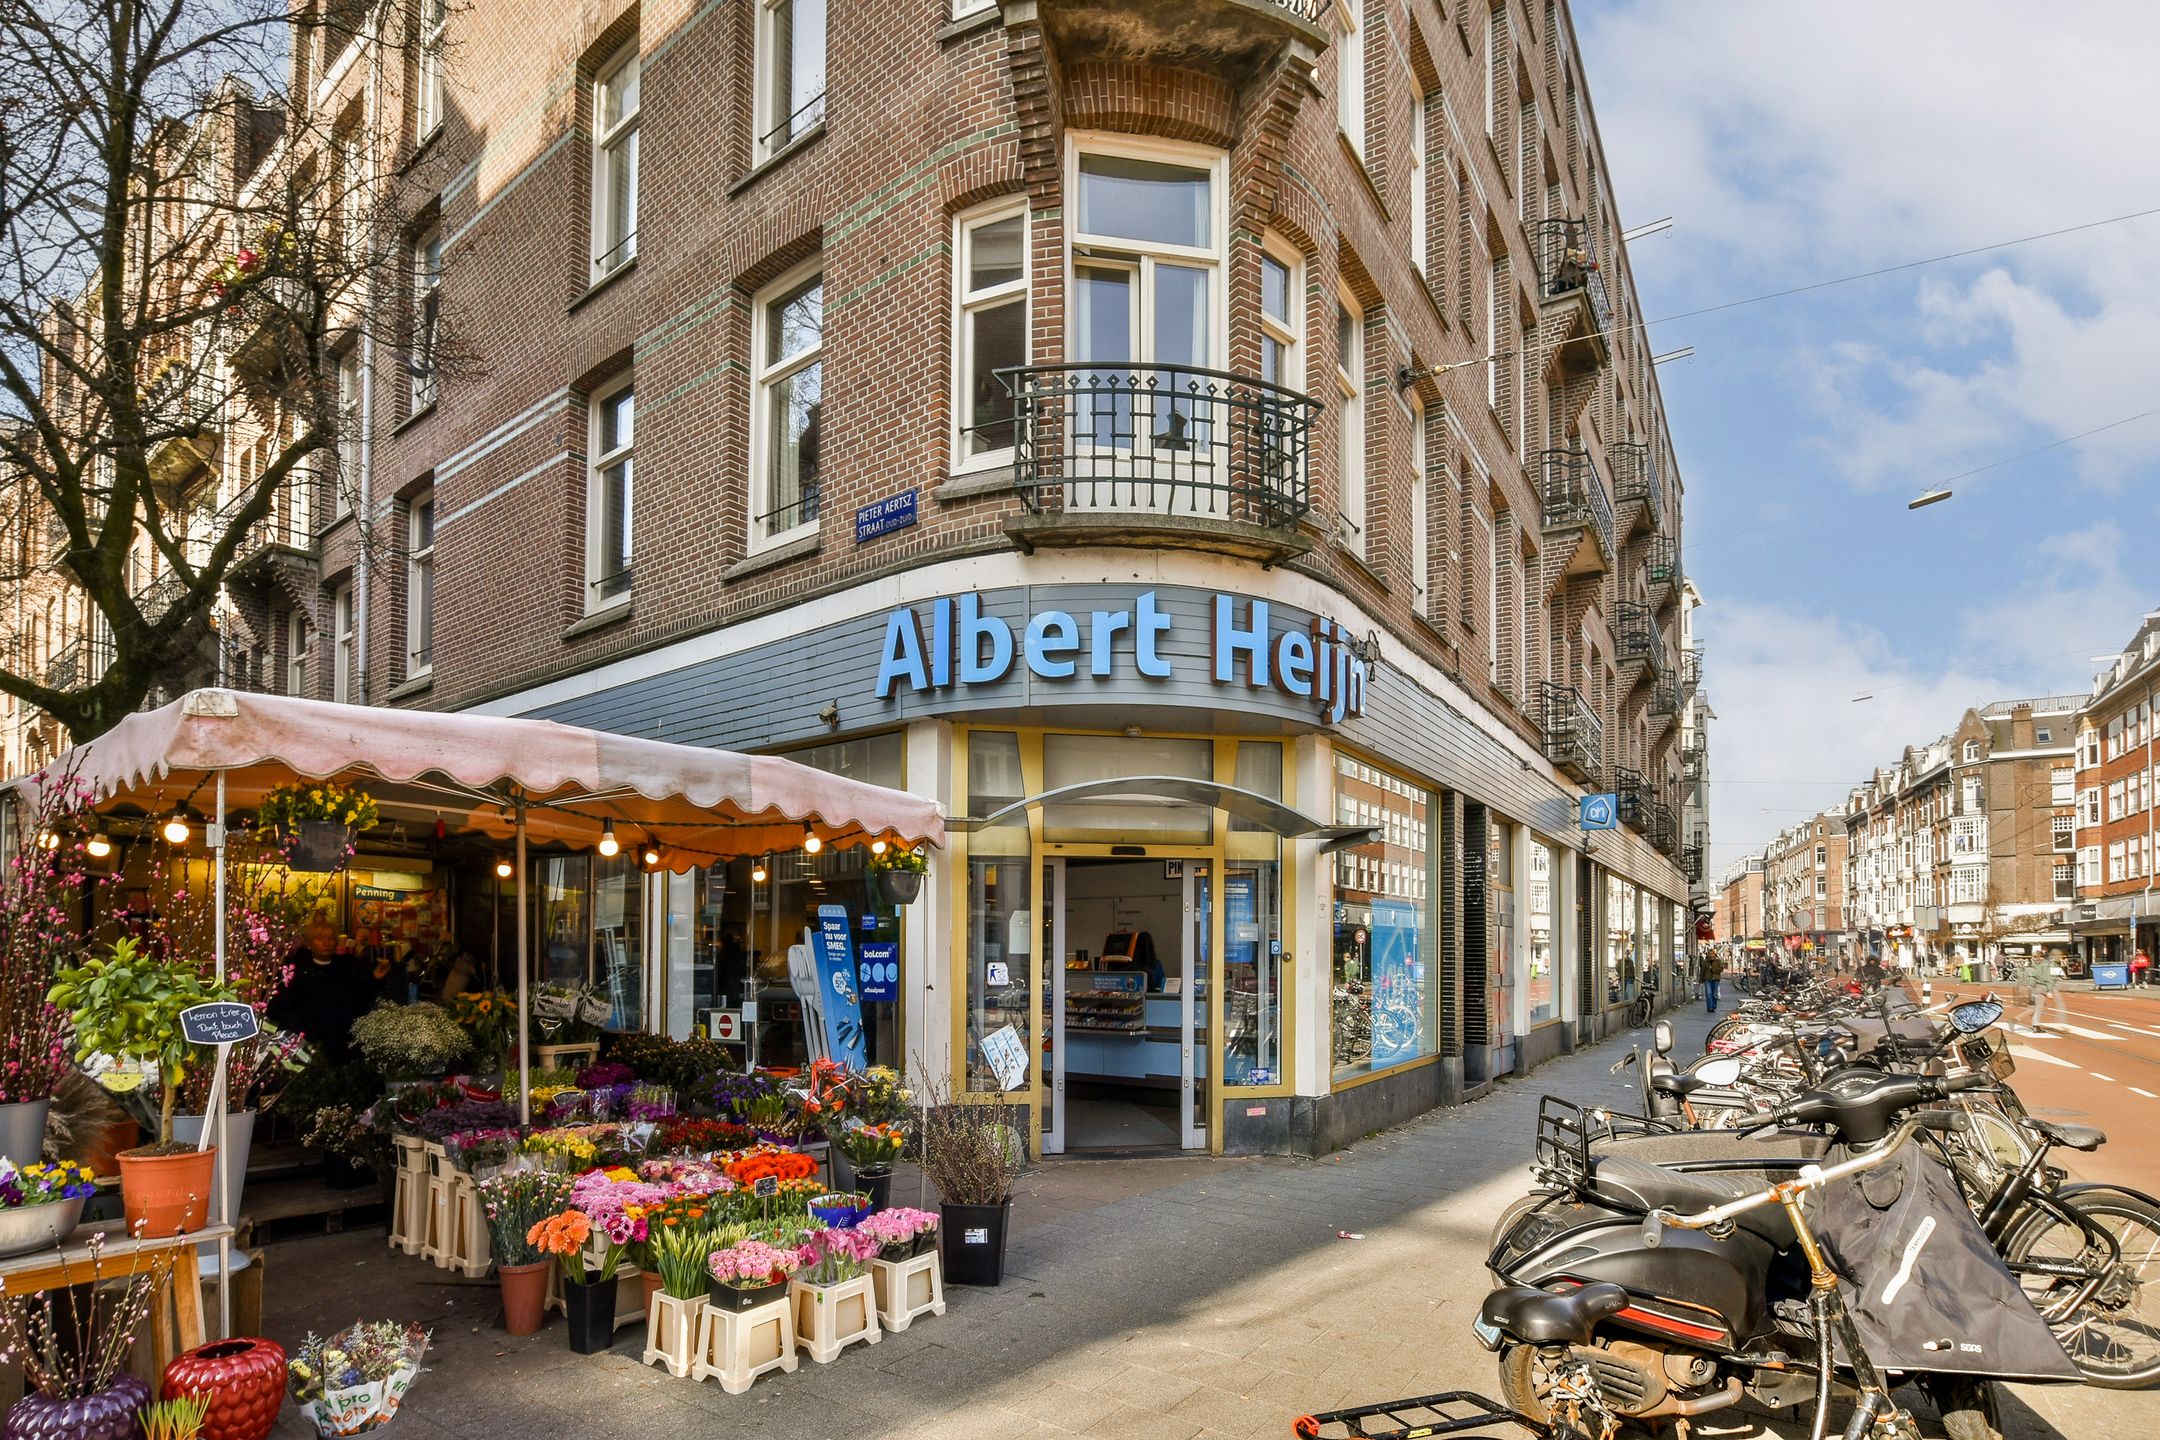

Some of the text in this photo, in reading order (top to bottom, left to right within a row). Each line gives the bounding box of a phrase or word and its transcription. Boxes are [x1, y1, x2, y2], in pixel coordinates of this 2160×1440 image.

[858, 494, 912, 524] PIETER AERTSZ
[858, 518, 885, 538] STRAAT
[875, 591, 1366, 725] Albert Heijn
[355, 887, 395, 900] Penning
[823, 921, 841, 931] Spaar
[834, 933, 847, 941] voor
[220, 1007, 240, 1018] tree
[221, 1020, 243, 1031] touch
